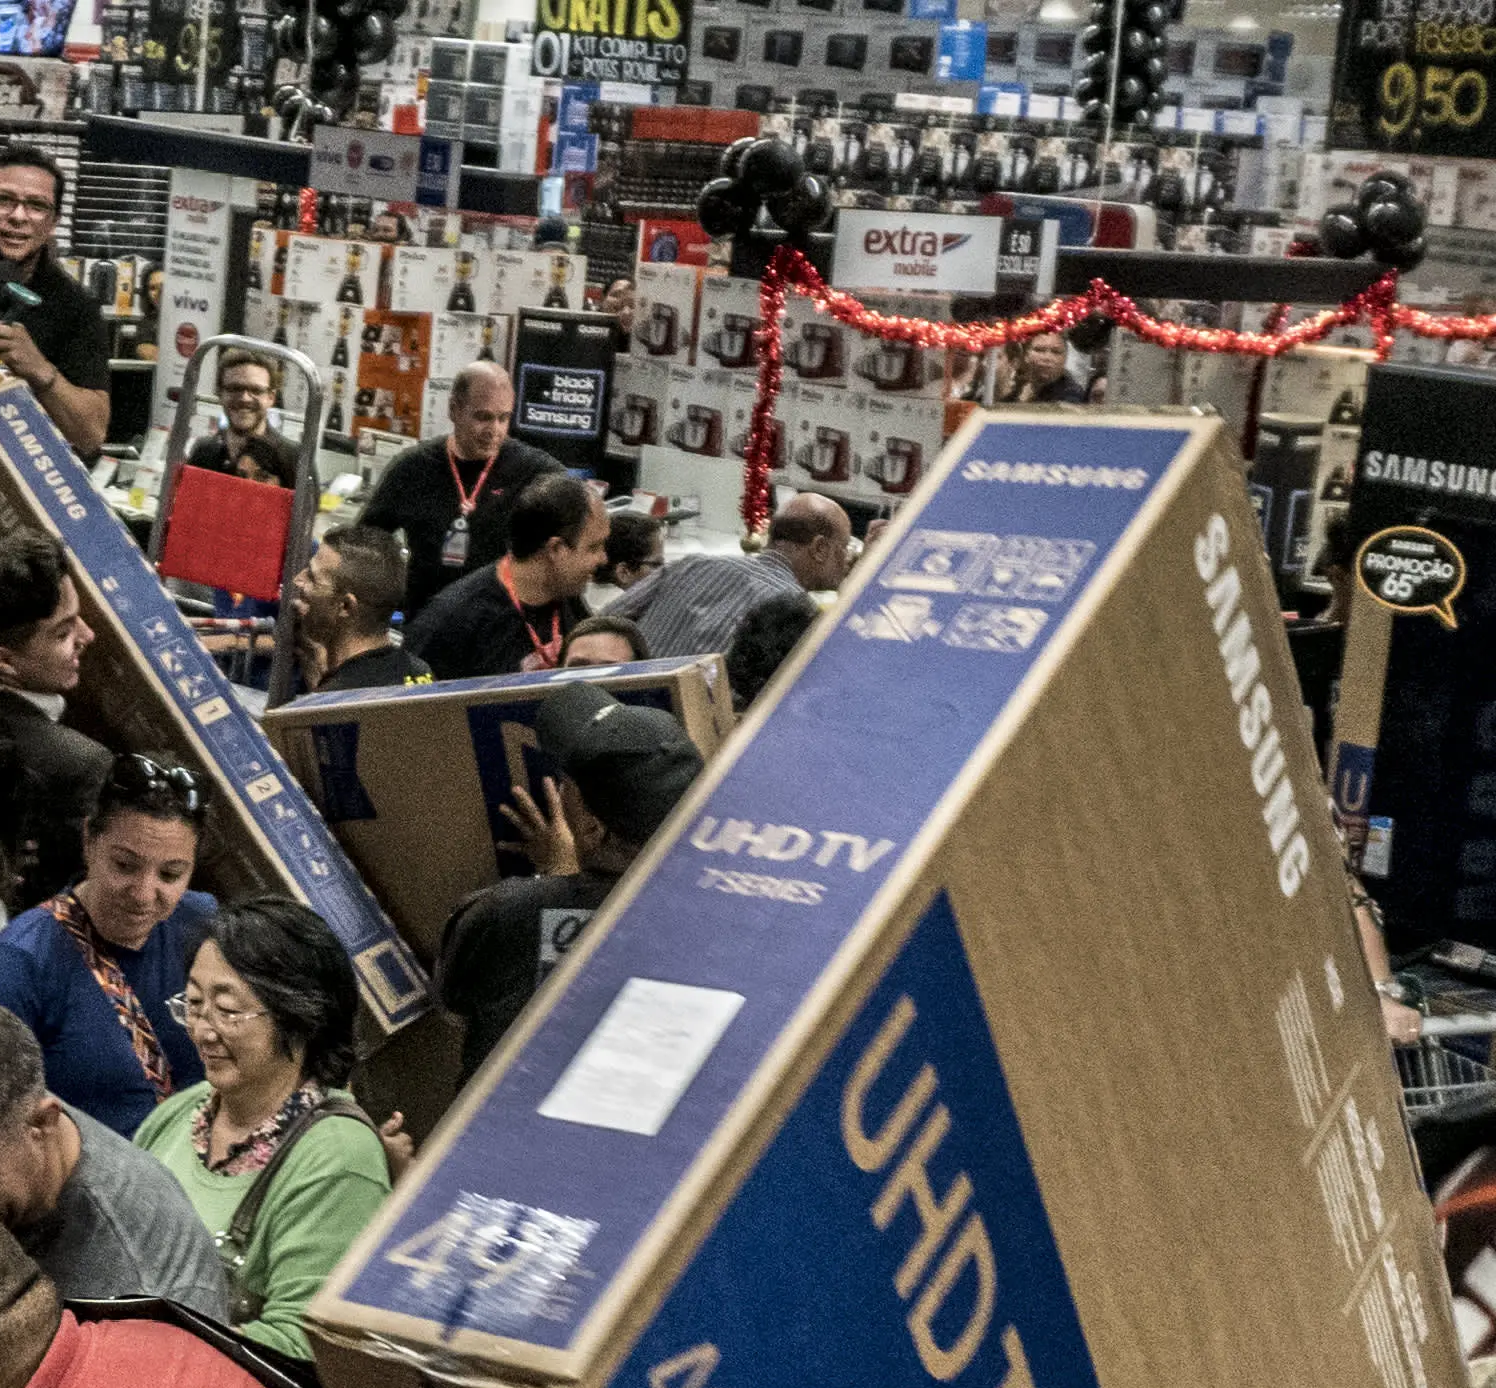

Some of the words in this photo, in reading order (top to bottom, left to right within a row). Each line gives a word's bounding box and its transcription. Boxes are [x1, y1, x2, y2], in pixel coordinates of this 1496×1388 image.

[599, 37, 687, 65] COMPLETO
[863, 224, 939, 257] extra
[892, 260, 938, 277] mobile
[553, 374, 595, 389] black
[551, 387, 595, 408] friday
[527, 407, 592, 430] Samsung
[961, 458, 1149, 491] SAMSUNG
[1365, 551, 1456, 581] PROMOÇÃO
[1194, 511, 1310, 899] SAMSUNG
[688, 816, 814, 862] UHD
[807, 830, 898, 873] TV
[711, 868, 828, 906] SERIES
[839, 995, 1000, 1382] UHD
